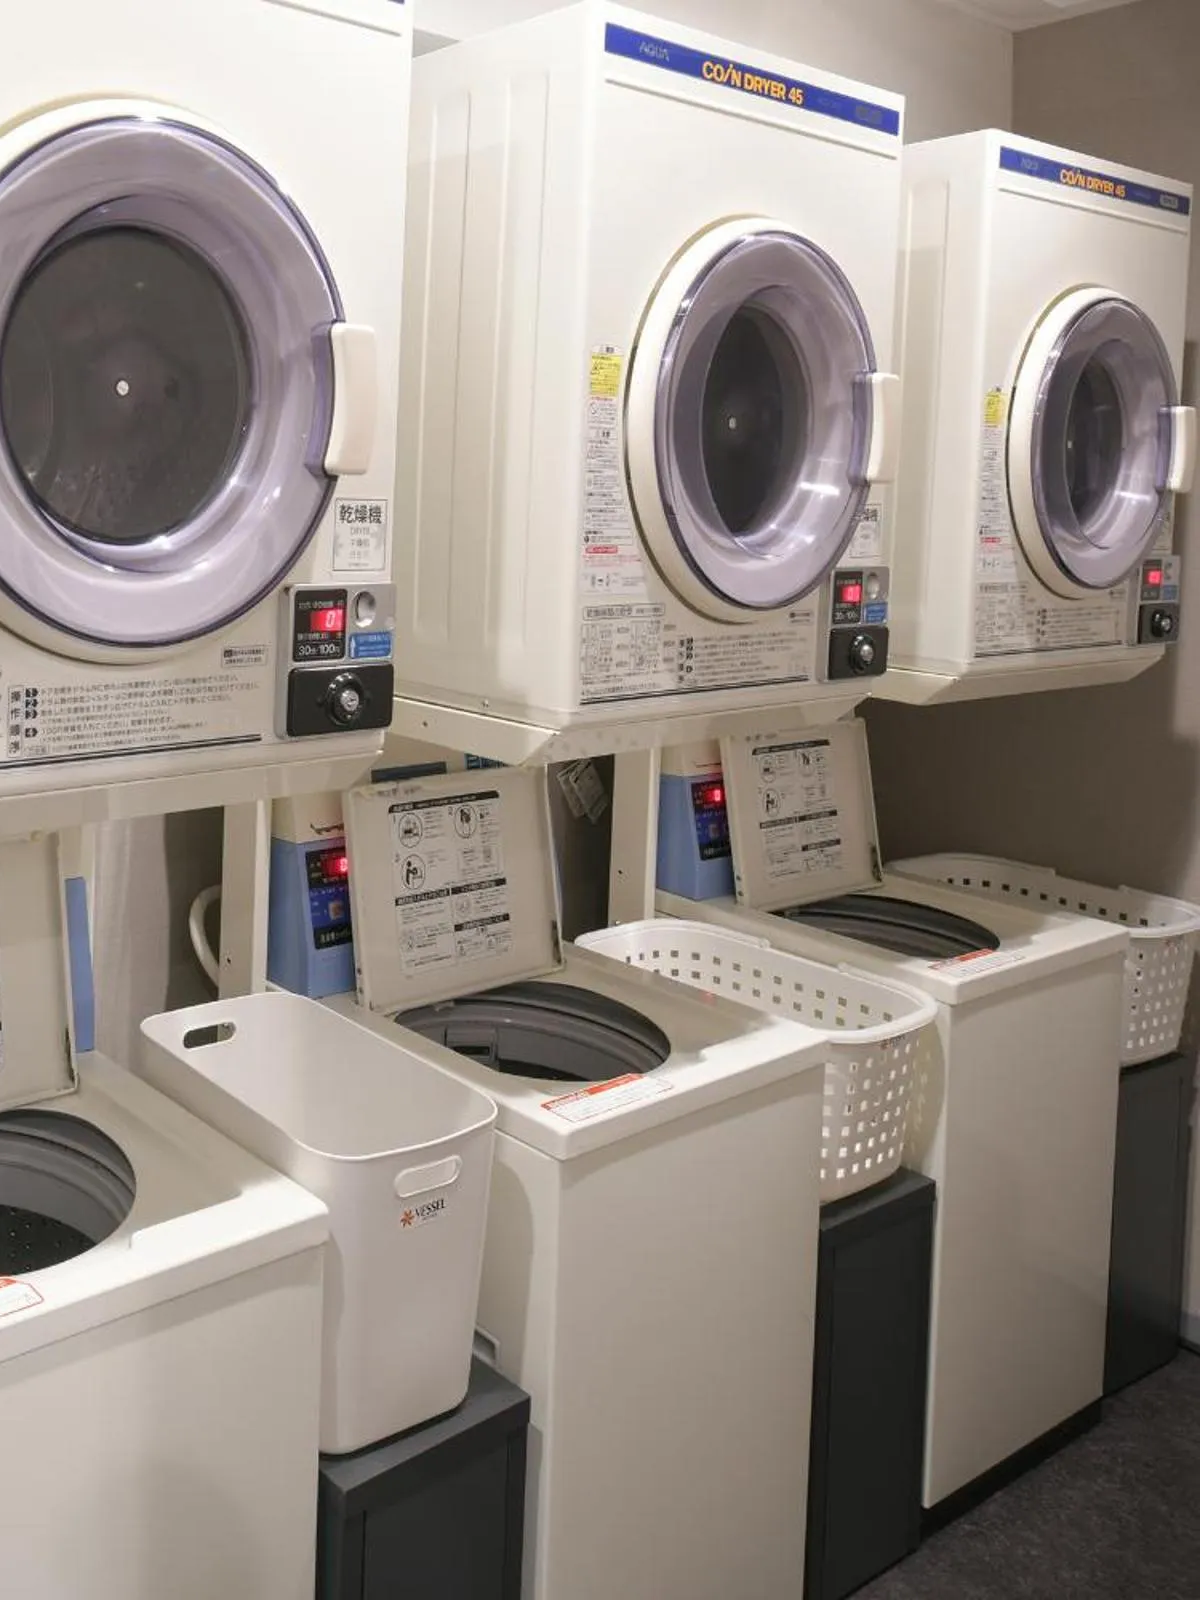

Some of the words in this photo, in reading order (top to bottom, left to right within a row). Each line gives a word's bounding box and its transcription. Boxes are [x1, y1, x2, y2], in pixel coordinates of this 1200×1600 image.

[639, 41, 670, 62] AQUA
[743, 73, 786, 101] DRYER
[787, 88, 804, 106] 45
